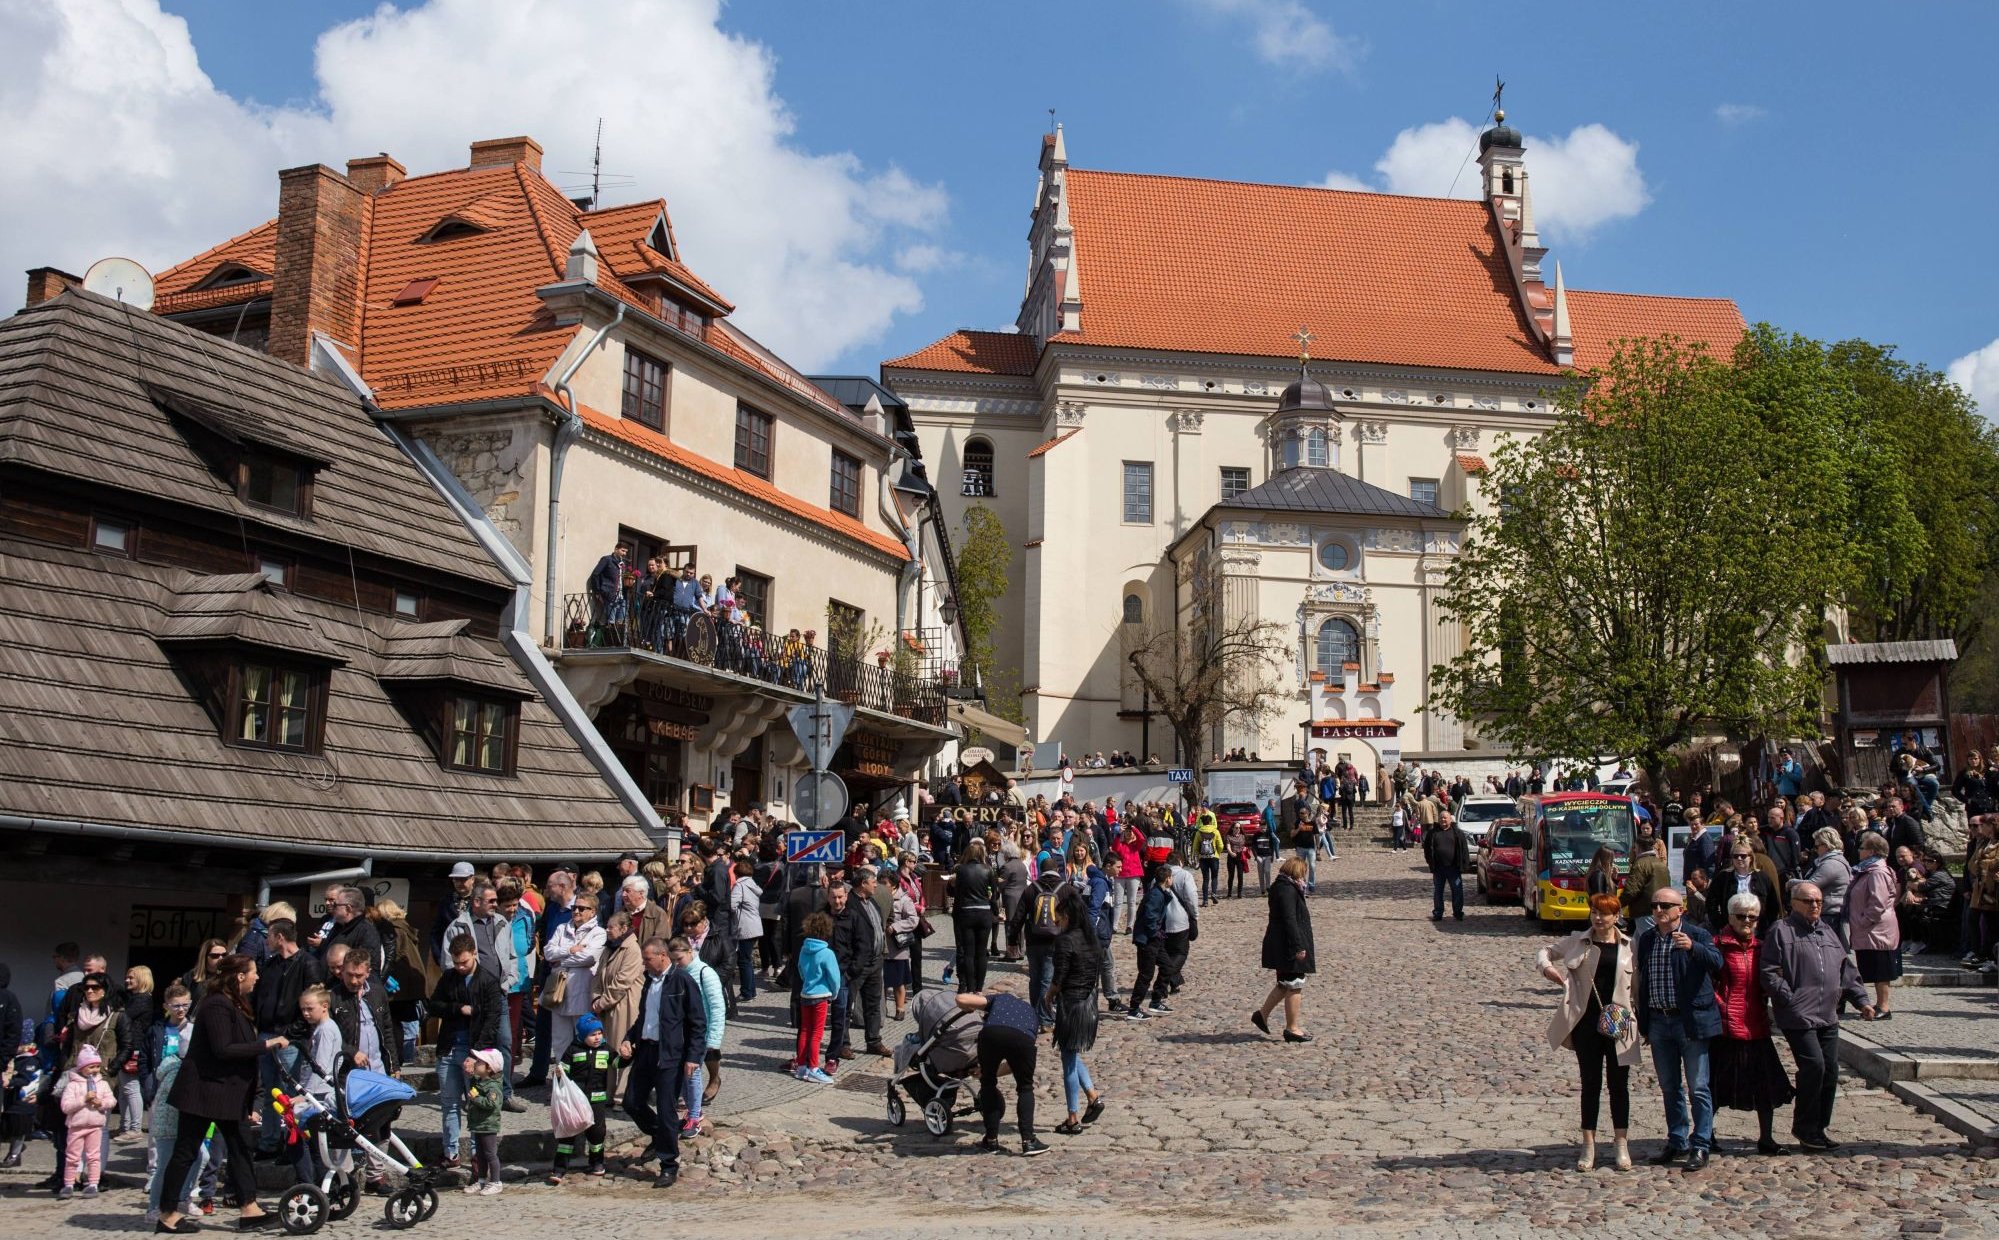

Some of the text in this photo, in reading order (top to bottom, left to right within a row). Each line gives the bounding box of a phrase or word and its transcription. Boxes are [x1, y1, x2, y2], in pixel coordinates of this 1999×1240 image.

[657, 719, 696, 741] KEBAB
[1322, 727, 1386, 737] PASCHA
[866, 762, 889, 775] LODY
[1169, 771, 1192, 780] TAXI
[791, 836, 841, 859] TAXI
